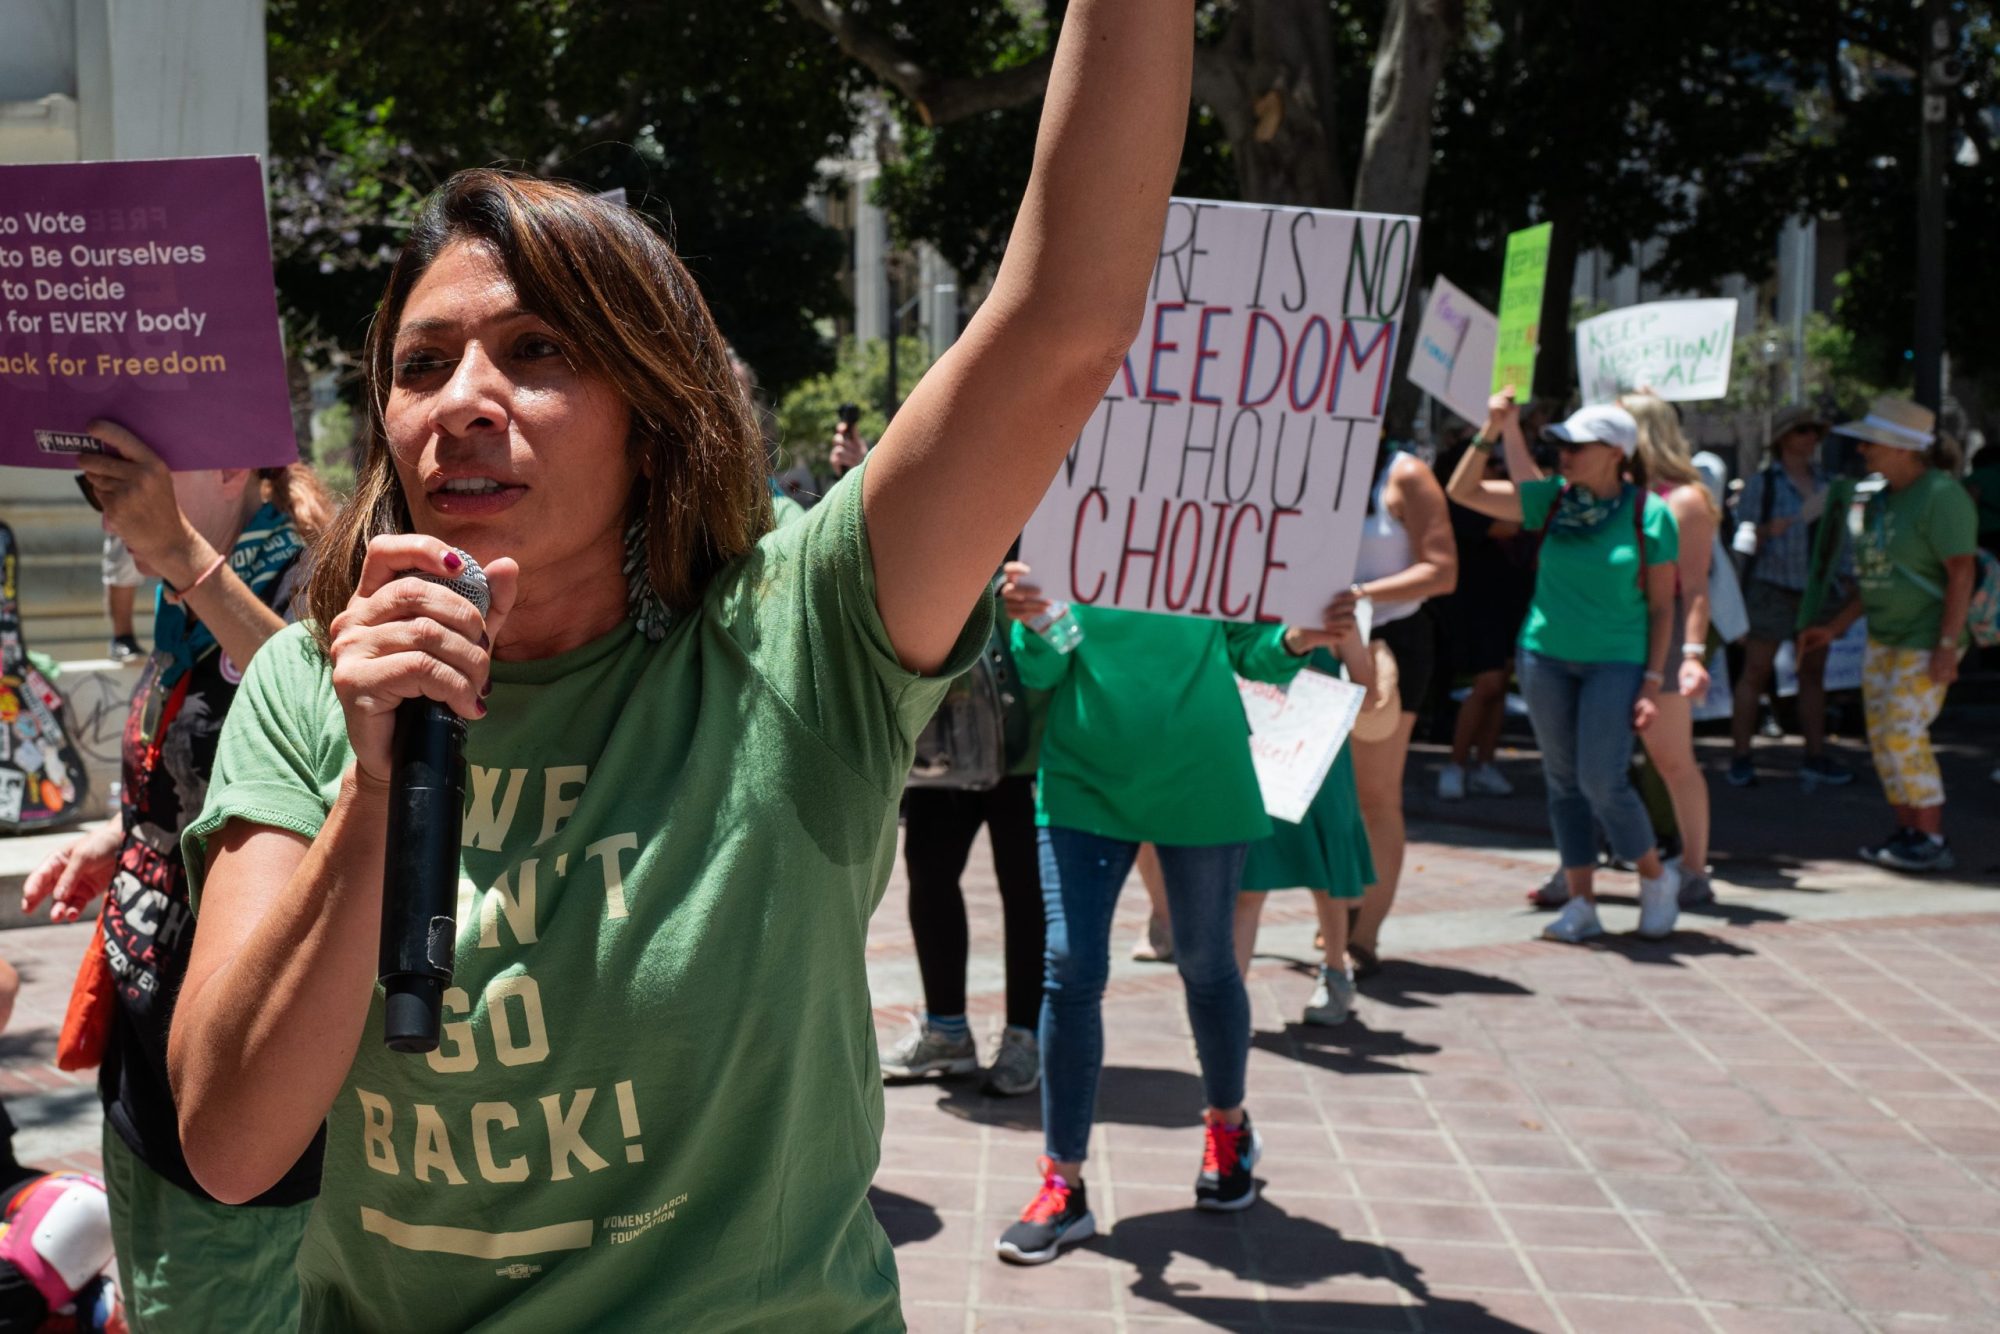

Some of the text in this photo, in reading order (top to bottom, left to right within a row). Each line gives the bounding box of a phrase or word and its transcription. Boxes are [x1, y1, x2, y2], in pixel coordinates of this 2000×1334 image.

[25, 212, 86, 234] Vote
[0, 241, 206, 268] to Be Ourselves
[1246, 208, 1316, 313] IS
[1342, 217, 1410, 322] NO
[2, 277, 125, 301] to Decide
[7, 307, 207, 337] for EVERY body
[47, 352, 87, 376] for
[97, 350, 226, 376] Freedom
[1122, 301, 1396, 416] EEDOM
[54, 434, 99, 449] NARAL
[1070, 489, 1303, 624] CHOICE
[461, 764, 588, 853] WE
[424, 975, 550, 1073] GO
[355, 1080, 645, 1185] BACK!
[652, 1192, 688, 1218] MARCH
